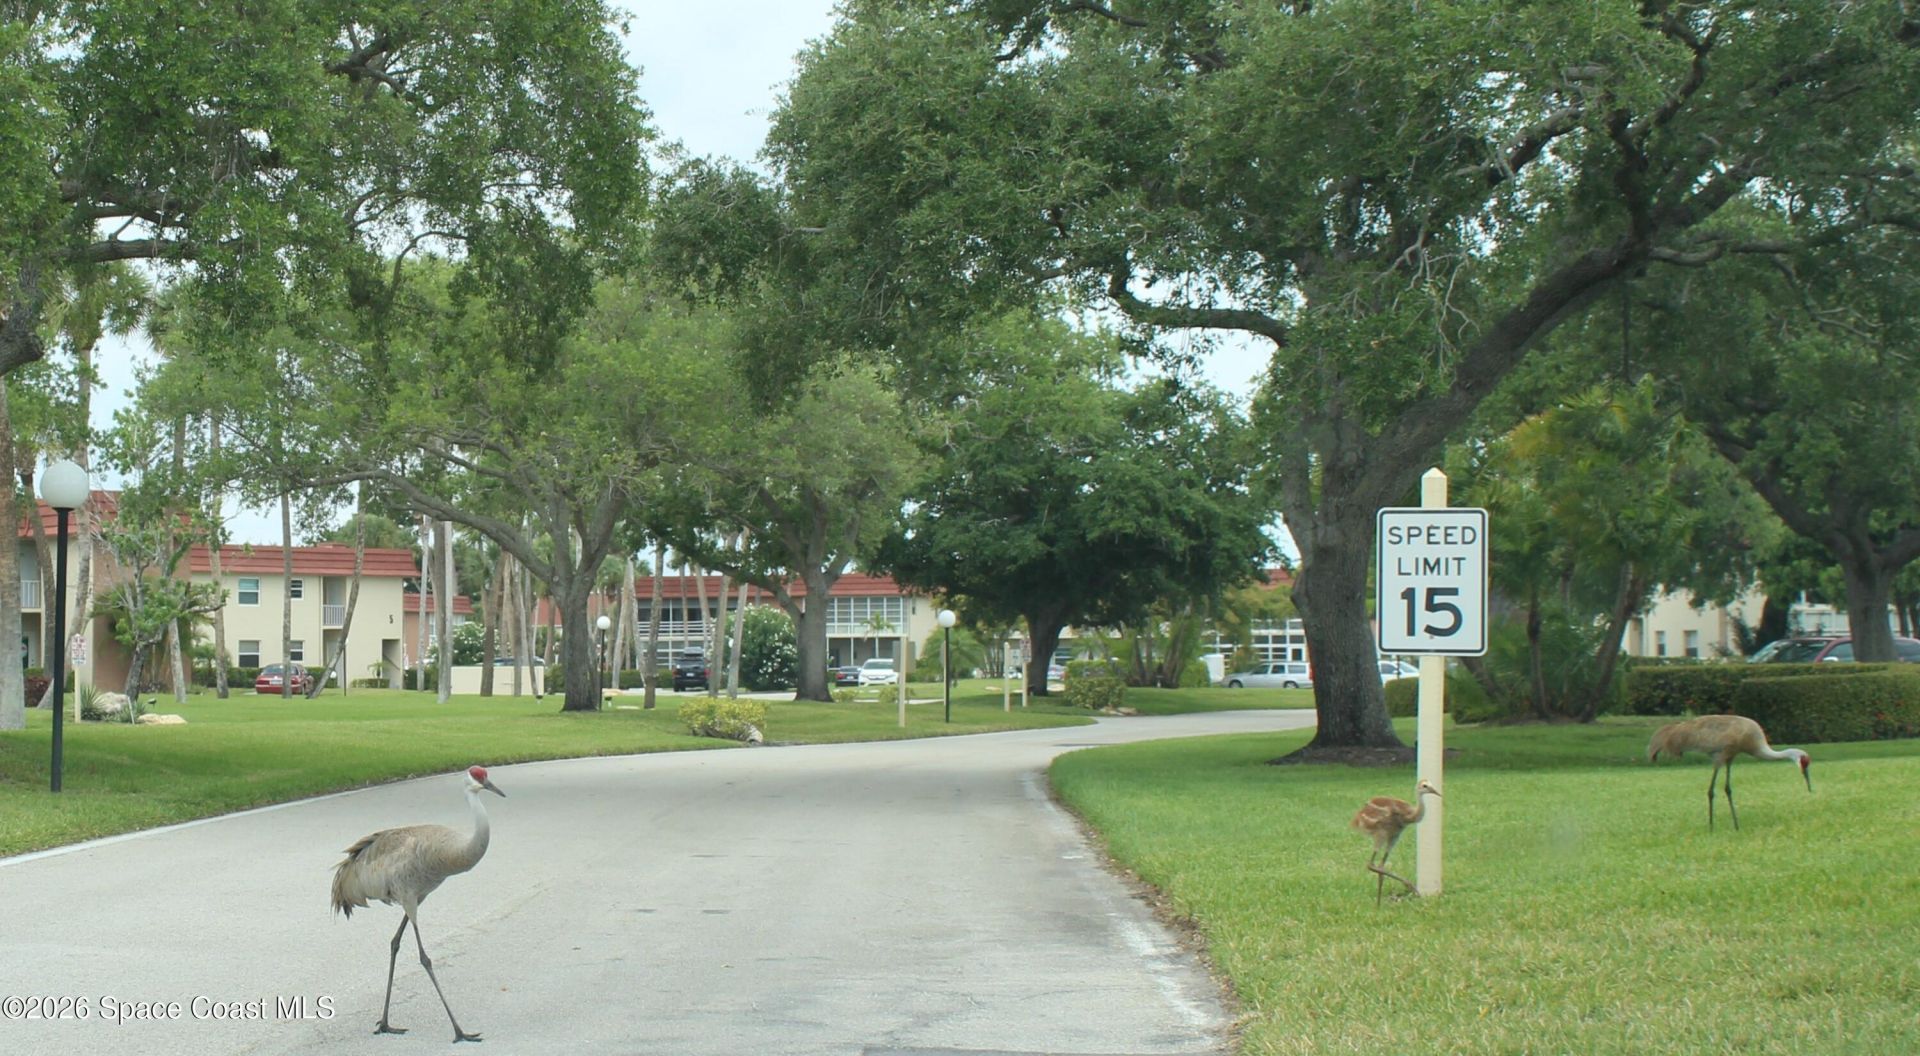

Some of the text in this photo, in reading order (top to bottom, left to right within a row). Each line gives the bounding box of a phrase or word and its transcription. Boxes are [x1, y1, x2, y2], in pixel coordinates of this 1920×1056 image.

[1388, 526, 1476, 545] SPEED
[1397, 557, 1466, 576] LIMIT
[1400, 587, 1463, 636] 15
